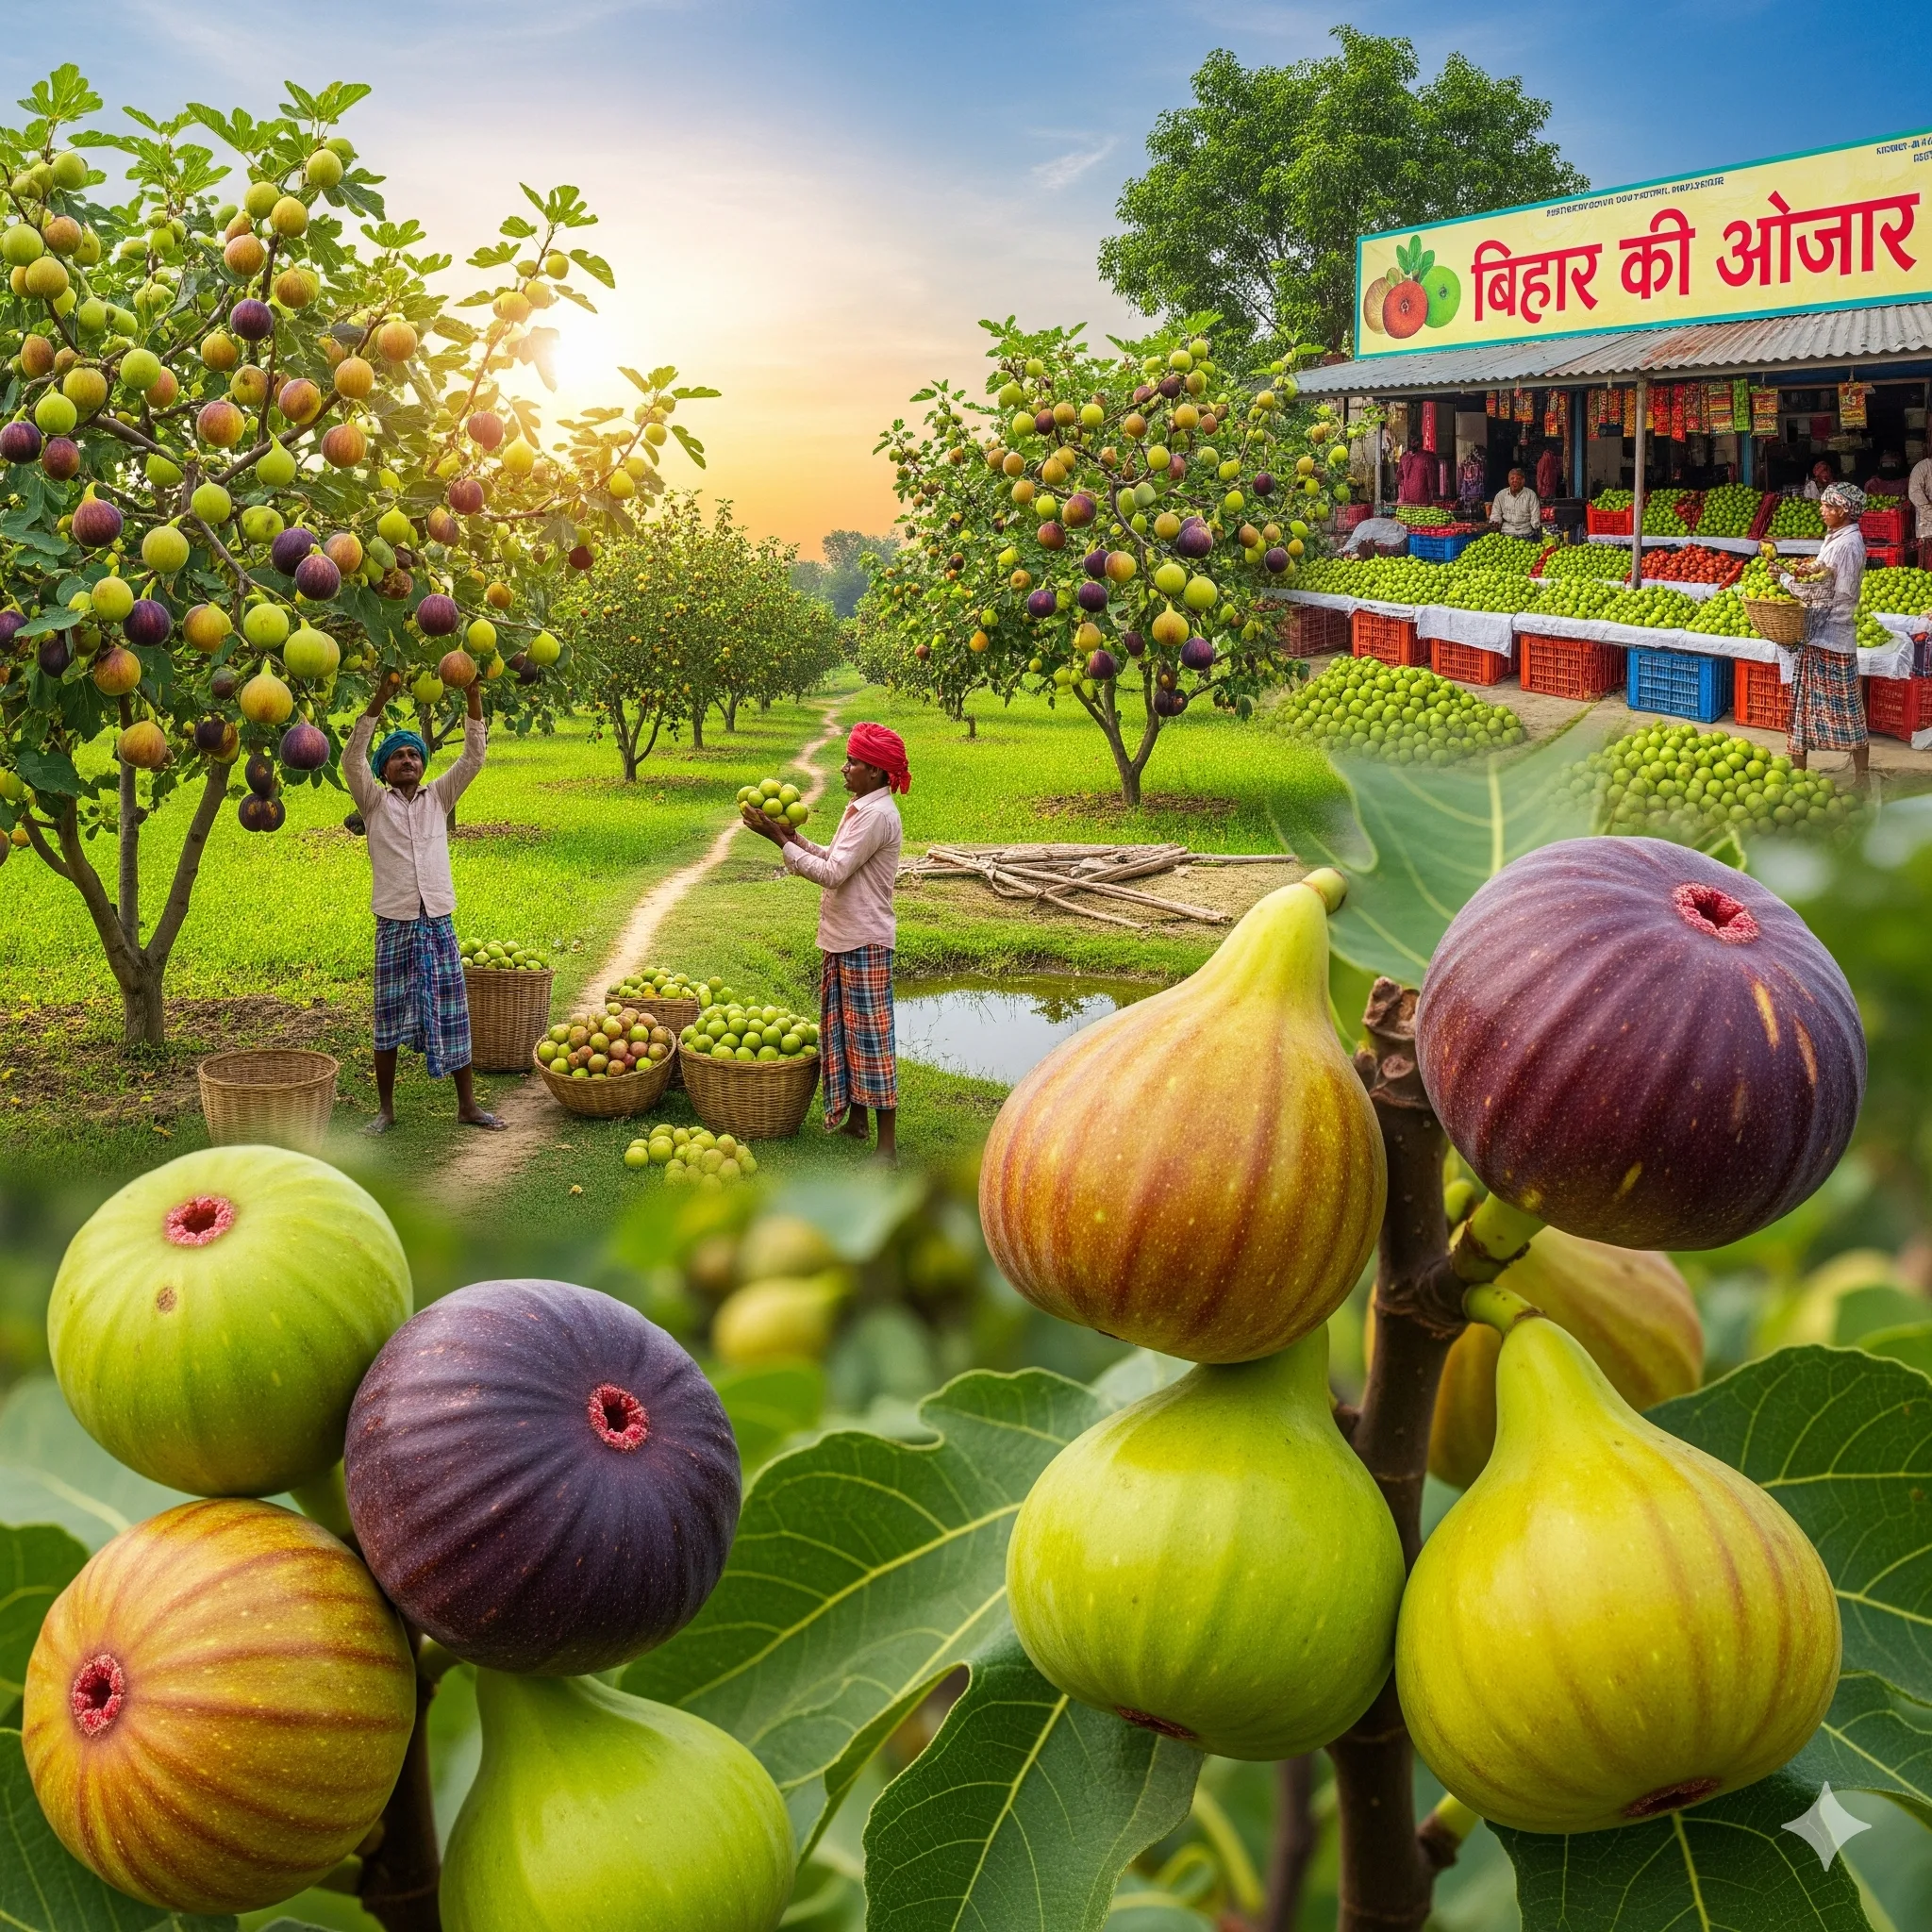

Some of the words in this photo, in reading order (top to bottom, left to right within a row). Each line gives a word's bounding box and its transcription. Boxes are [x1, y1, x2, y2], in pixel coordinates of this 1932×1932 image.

[1470, 239, 1602, 324] बिहार
[1618, 208, 1695, 299] की
[1716, 191, 1920, 287] ओजार
